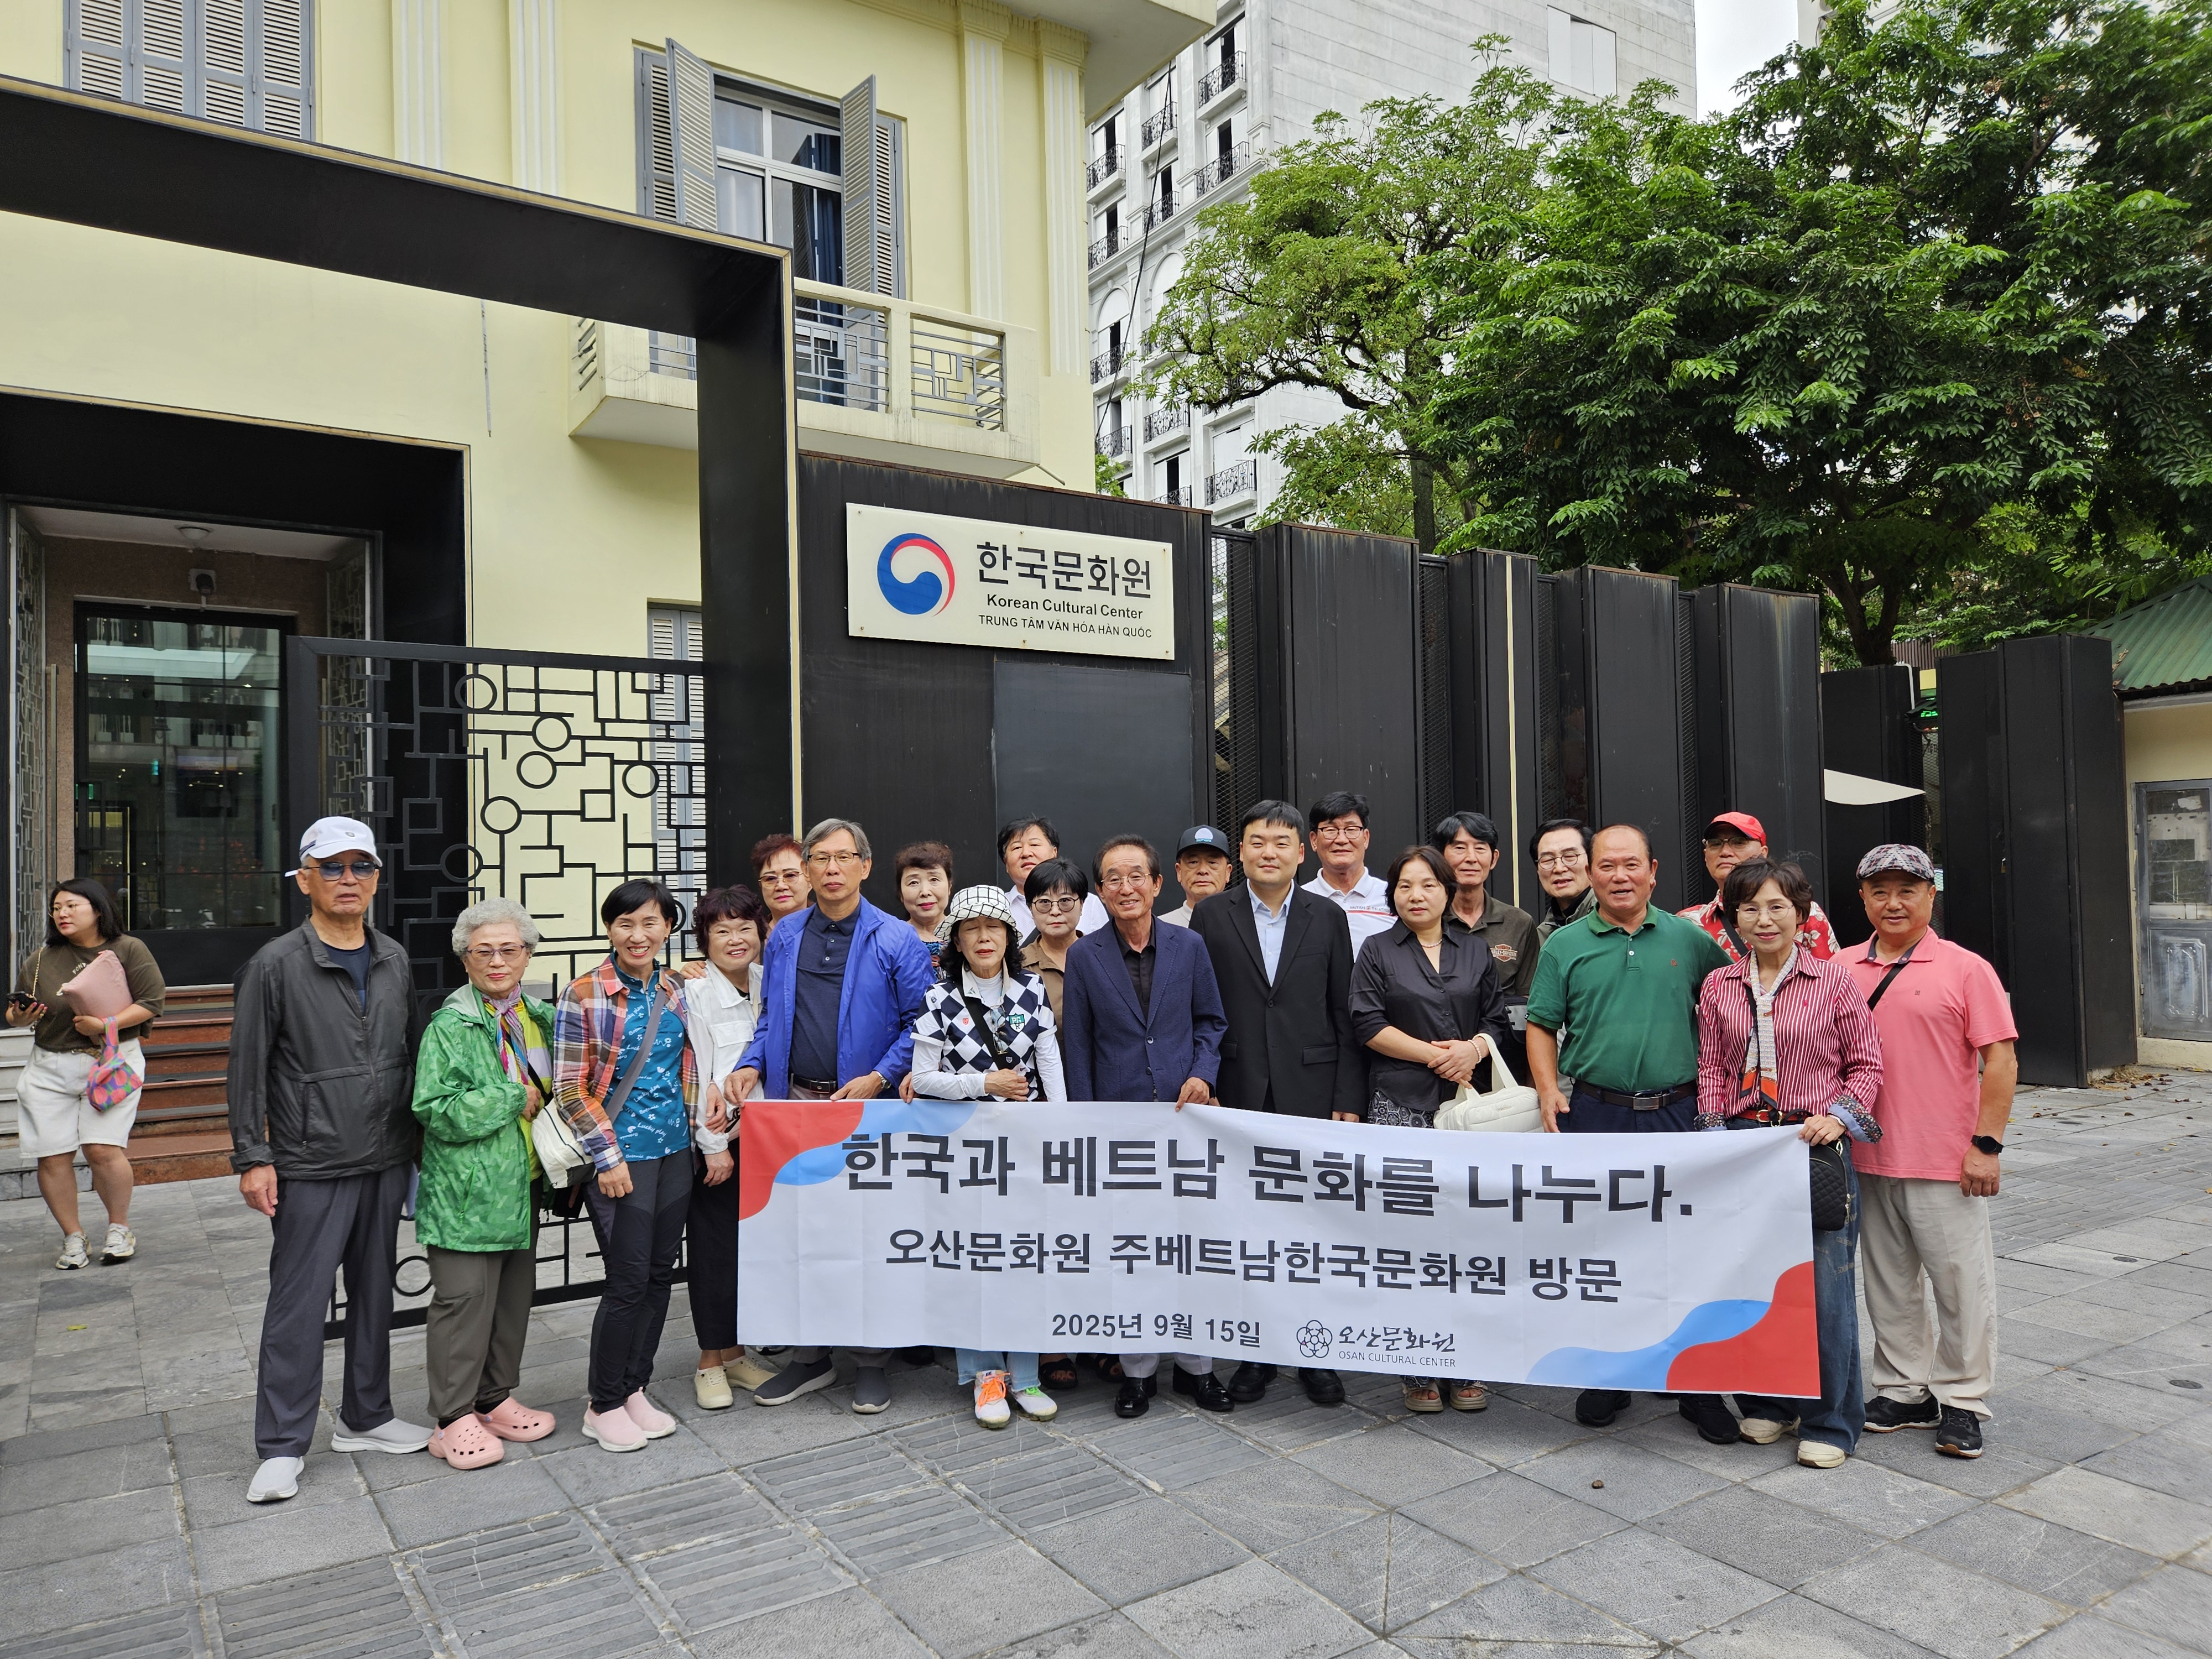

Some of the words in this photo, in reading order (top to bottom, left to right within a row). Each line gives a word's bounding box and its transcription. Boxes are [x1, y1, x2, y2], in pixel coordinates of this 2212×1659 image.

[977, 541, 1151, 599] 한국문화원
[987, 593, 1039, 610] Korean
[1042, 599, 1097, 615] Cultural
[1100, 604, 1143, 619] Center
[978, 614, 1018, 627] TRUNG
[1021, 617, 1044, 629] TÂM
[1047, 619, 1069, 632] VĂN
[1073, 622, 1095, 634] HÓA
[1098, 623, 1119, 635] HÀN
[842, 1133, 1015, 1197] 한국과
[1042, 1136, 1225, 1200] 베트남
[1249, 1145, 1439, 1217] 문화를
[1468, 1164, 1693, 1224] 나누다.
[886, 1229, 1091, 1274] 오산문화원
[1109, 1234, 1506, 1296] 주베트남한국문화원
[1530, 1257, 1622, 1303] 방문
[1052, 1313, 1142, 1339] 2025년
[1154, 1313, 1193, 1340] 9월
[1205, 1318, 1260, 1348] 15일
[1339, 1326, 1455, 1352] 오산문화원
[1339, 1351, 1365, 1360] OSAN
[1368, 1353, 1416, 1365] CULTURAL
[1420, 1357, 1456, 1368] CENTER
